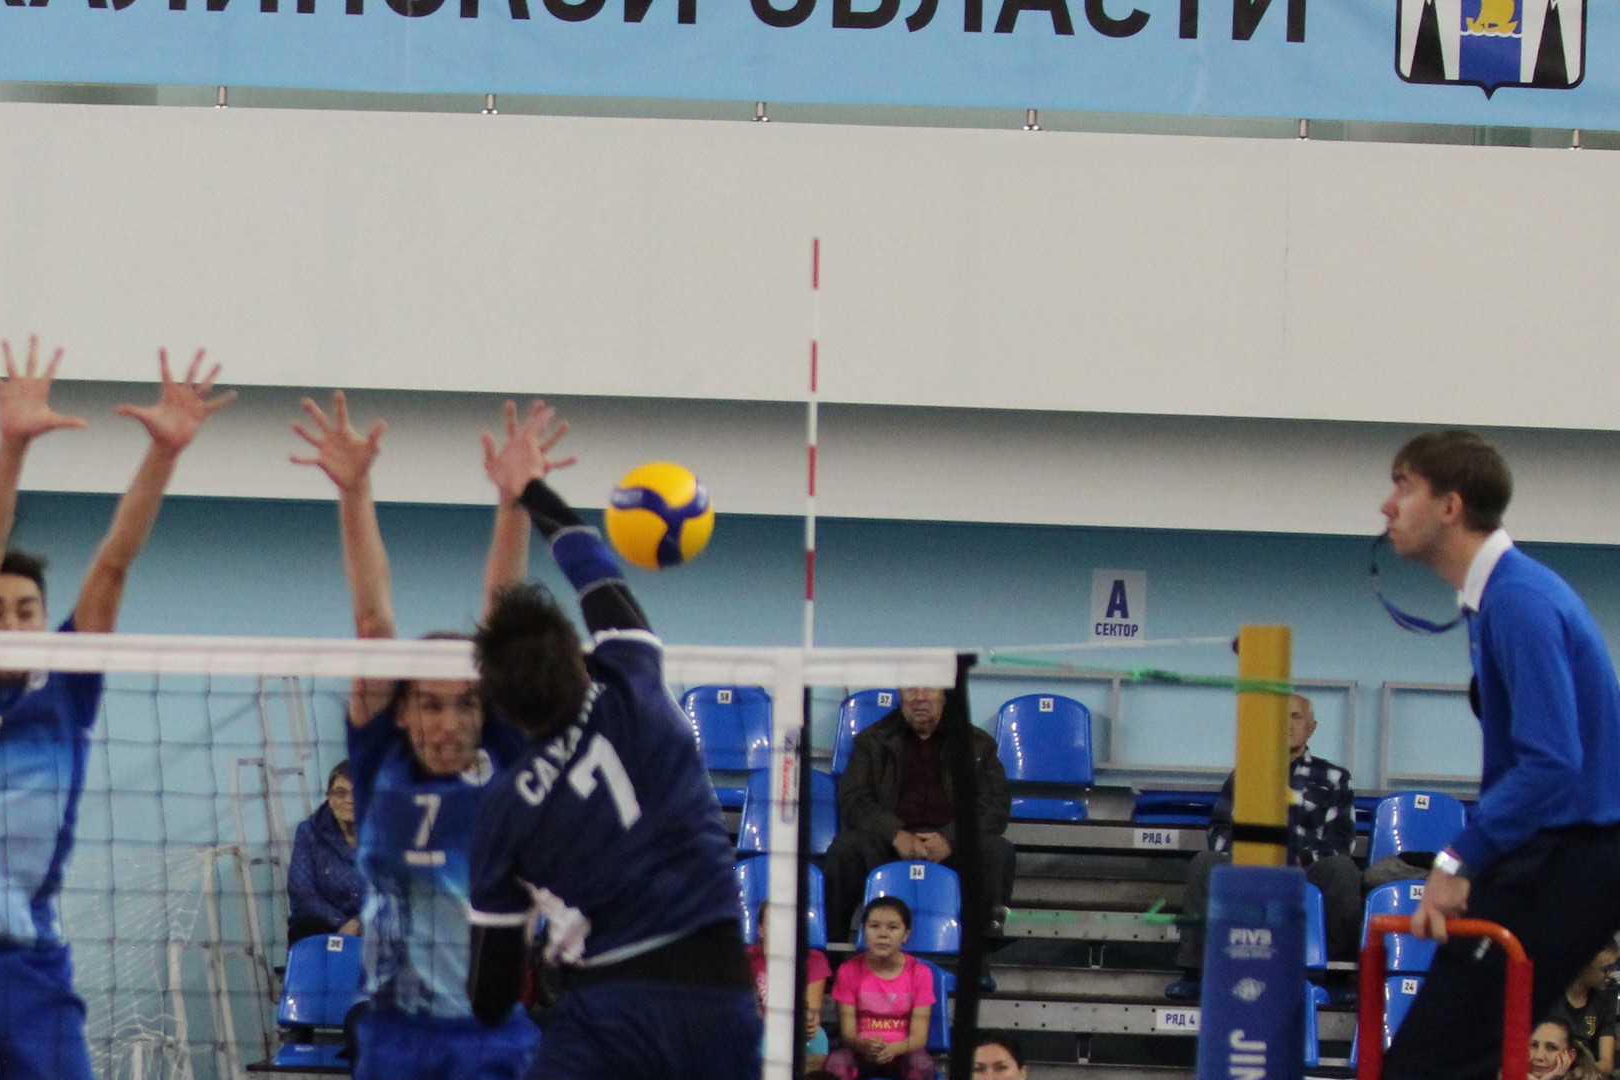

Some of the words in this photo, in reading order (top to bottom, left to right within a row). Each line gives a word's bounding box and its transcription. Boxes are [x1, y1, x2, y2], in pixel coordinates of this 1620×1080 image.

[1105, 579, 1130, 619] А
[1095, 622, 1139, 638] СЕКТОР
[567, 733, 642, 831] 7
[411, 794, 442, 848] 7
[1142, 832, 1162, 845] РЯД
[1165, 832, 1172, 844] 6
[1165, 1013, 1186, 1027] РЯД
[1189, 1014, 1196, 1025] 4
